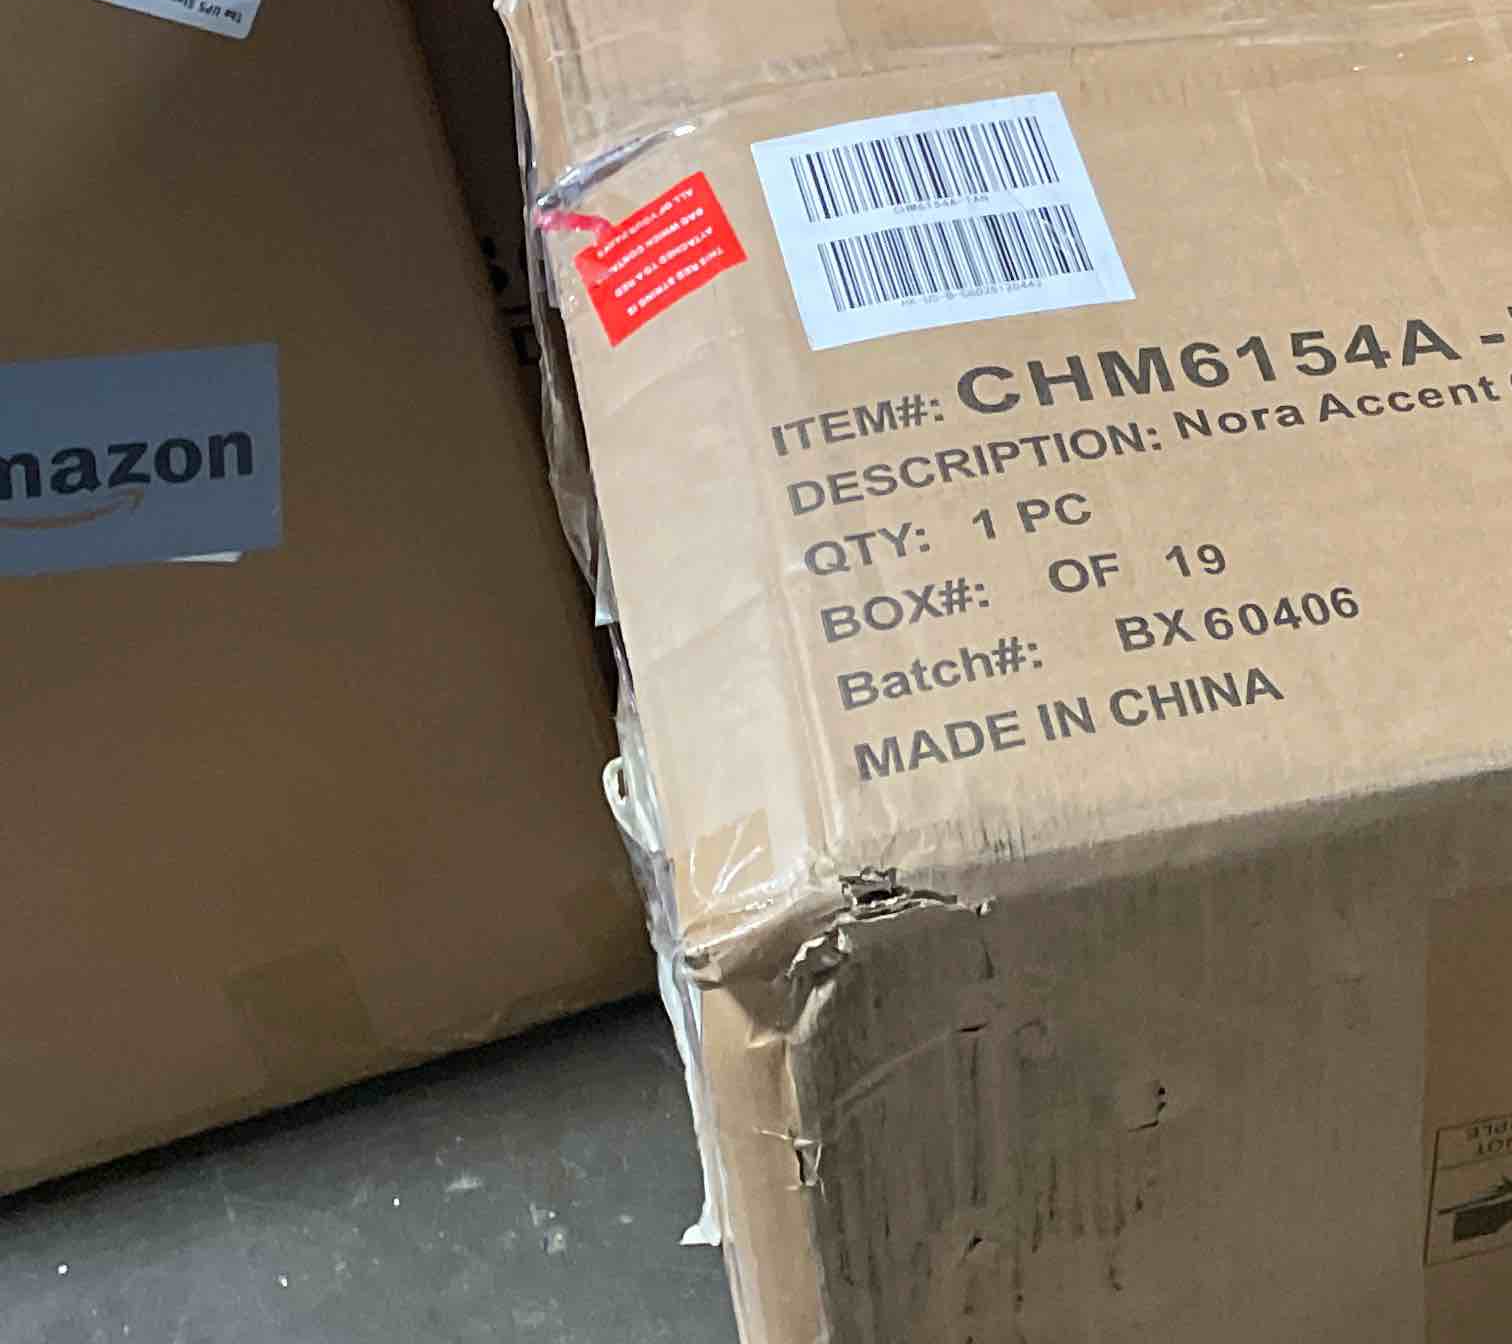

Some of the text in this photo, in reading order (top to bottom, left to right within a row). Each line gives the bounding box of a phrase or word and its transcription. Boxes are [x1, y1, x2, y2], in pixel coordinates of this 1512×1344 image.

[199, 2, 221, 17] UPS
[772, 394, 945, 456] ITEM#:
[787, 421, 1162, 516] DESCRIPTION:
[1173, 405, 1305, 441] Nora
[1319, 375, 1501, 422] Accent
[804, 492, 1092, 576] QTY: 1 PC
[820, 543, 1226, 643] BOX#: OF 19
[837, 636, 1043, 711] Batch#:
[854, 667, 1285, 782] MADE IN CHINA
